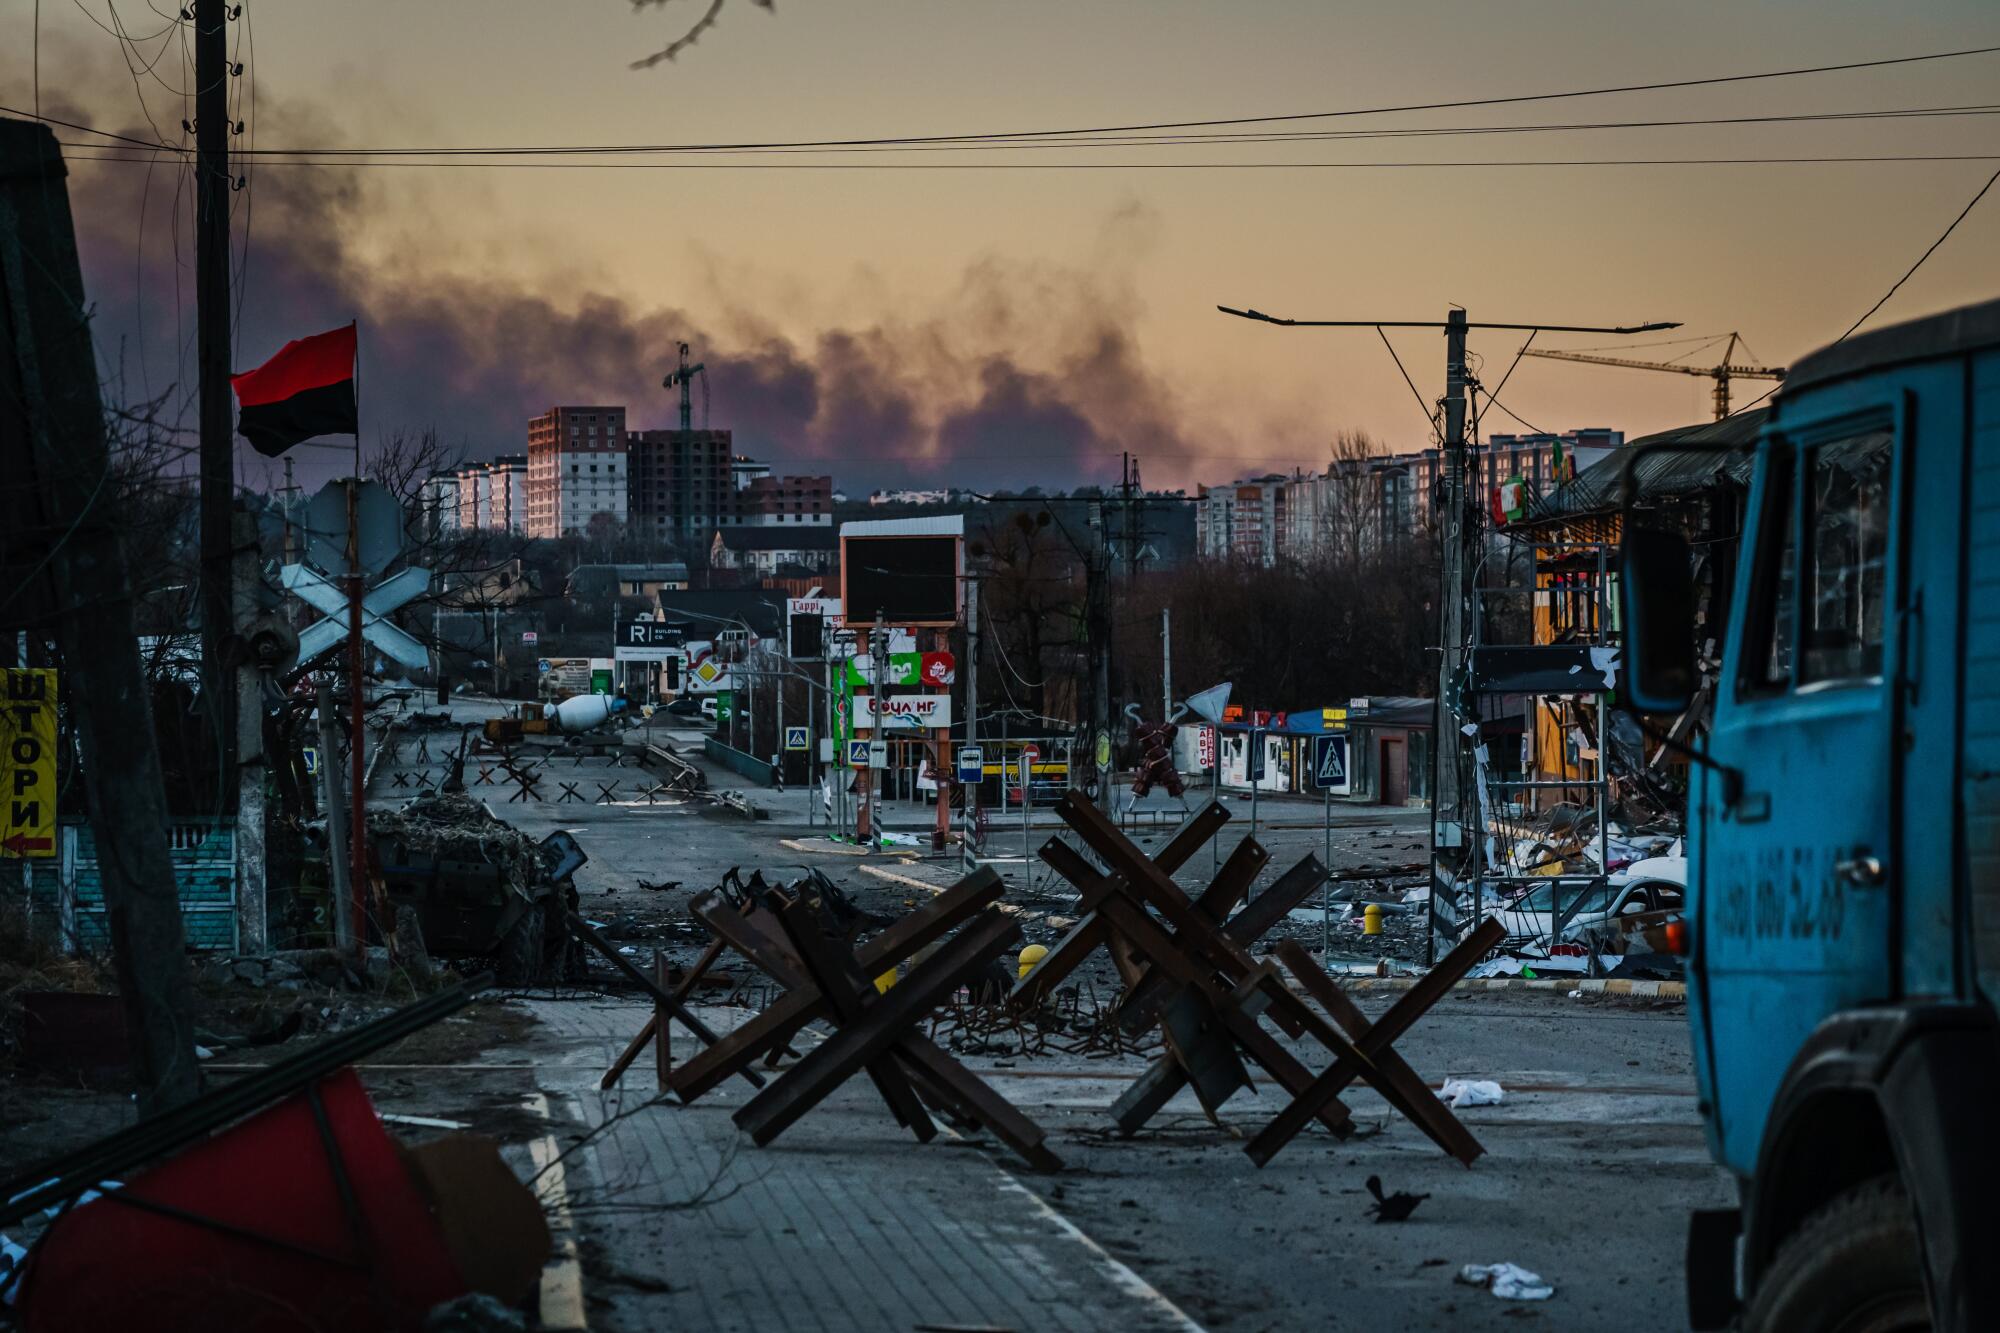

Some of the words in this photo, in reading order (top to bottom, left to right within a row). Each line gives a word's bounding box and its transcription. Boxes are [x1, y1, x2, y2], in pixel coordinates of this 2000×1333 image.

[630, 625, 645, 643] R
[8, 674, 46, 828] ШТОРИ
[1199, 731, 1207, 765] АВТО
